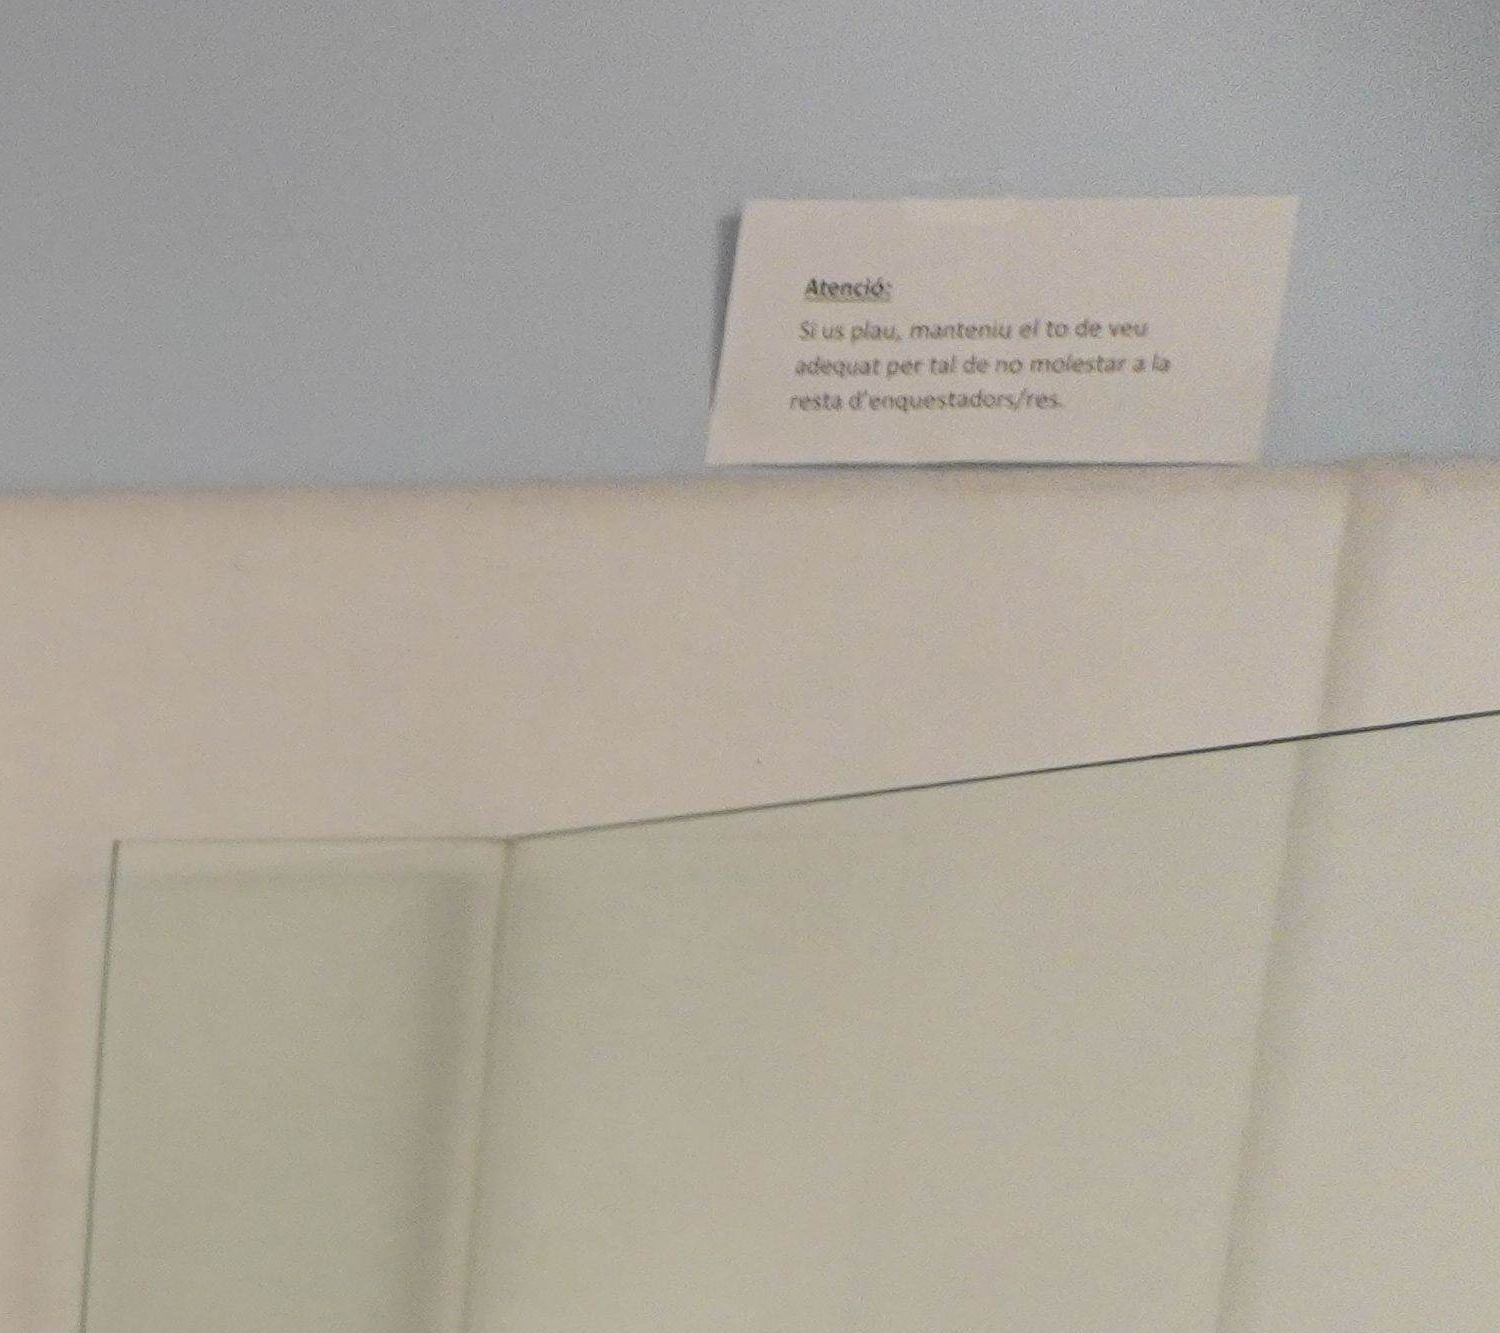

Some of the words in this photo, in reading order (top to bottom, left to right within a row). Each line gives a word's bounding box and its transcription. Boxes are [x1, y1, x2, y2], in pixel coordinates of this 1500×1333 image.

[804, 277, 892, 302] Atenció:
[799, 320, 817, 341] Si
[821, 325, 844, 340] us
[850, 319, 901, 343] plau,
[909, 321, 1013, 340] manteniu
[1019, 318, 1040, 339] el
[1047, 320, 1069, 339] to
[1074, 318, 1102, 339] de
[1108, 322, 1149, 338] veu
[795, 356, 880, 378] adequat
[885, 359, 924, 381] per
[930, 356, 955, 375] tal
[961, 354, 990, 374] de
[994, 357, 1024, 375] no
[1029, 353, 1125, 374] molestar
[1132, 359, 1146, 374] a
[1152, 352, 1171, 374] la
[789, 393, 842, 411] resta
